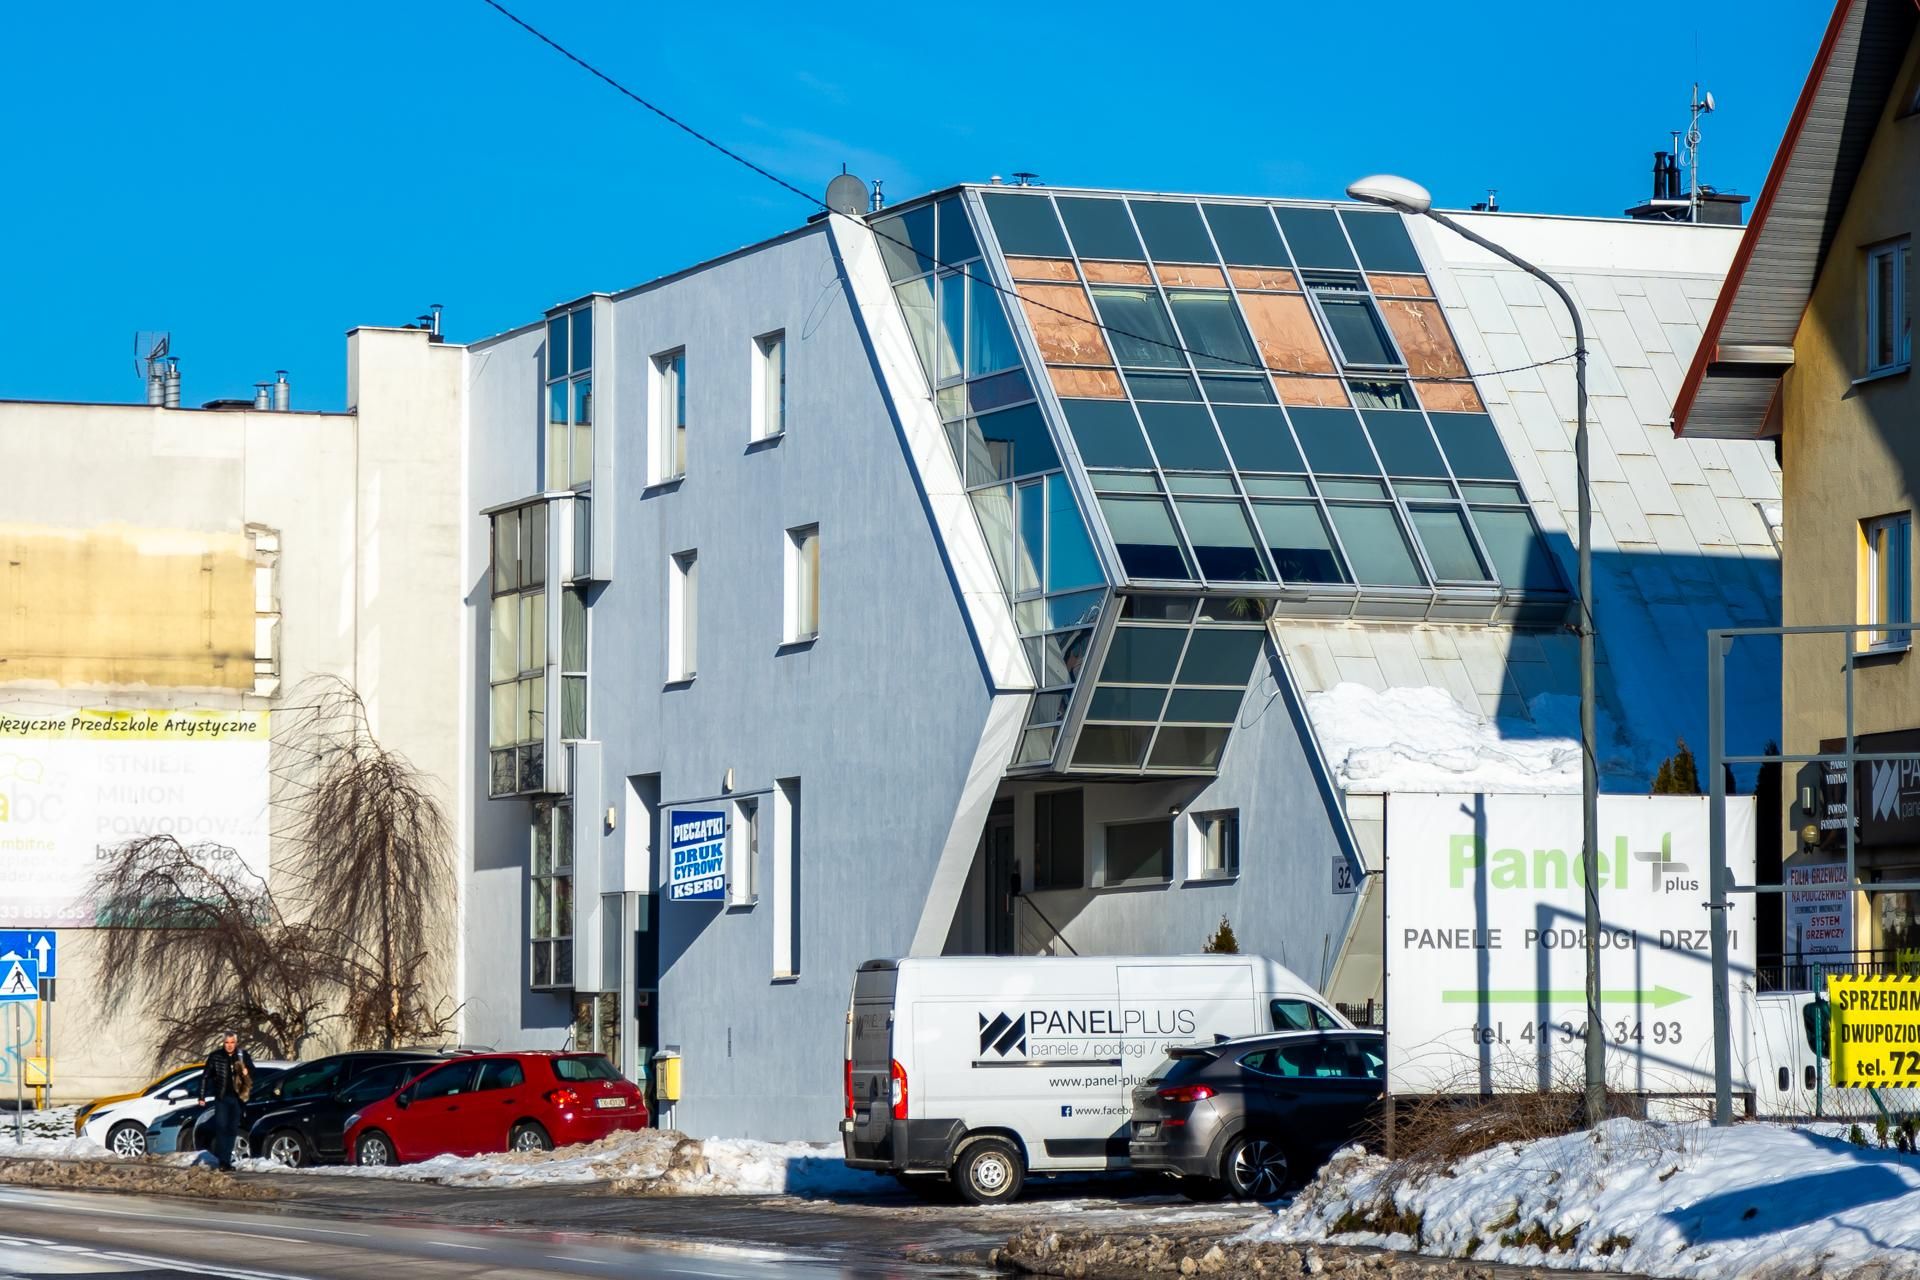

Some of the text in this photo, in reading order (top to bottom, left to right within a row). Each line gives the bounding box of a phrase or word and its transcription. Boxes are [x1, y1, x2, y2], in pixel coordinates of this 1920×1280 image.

[71, 716, 159, 732] Przedszkole
[165, 717, 257, 736] Artystyczne
[673, 817, 723, 842] PIECZĄTKI
[674, 843, 723, 866] DRUK
[1449, 834, 1629, 889] Panel
[674, 857, 723, 880] CYFROWY
[1337, 866, 1351, 889] 32
[1791, 866, 1848, 886] FOLIA GRZEWCZA
[673, 877, 724, 899] KSERO
[1665, 877, 1699, 893] plus
[1811, 915, 1840, 927] SYSTEM
[1403, 928, 1502, 950] PANELE
[1659, 929, 1738, 950] DRZI
[1806, 928, 1846, 940] GRZEWCZY
[1839, 989, 1920, 1011] SPRZEDAM
[1472, 1021, 1683, 1045] tel. 41 34 34 93
[1841, 1023, 1920, 1043] DWUPOZIO
[1031, 1041, 1079, 1058] panele
[1094, 1040, 1146, 1059] podłogi
[1857, 1051, 1920, 1076] tel. 72
[1049, 1074, 1146, 1088] www.panel-plus
[1075, 1105, 1133, 1116] www.facebo
